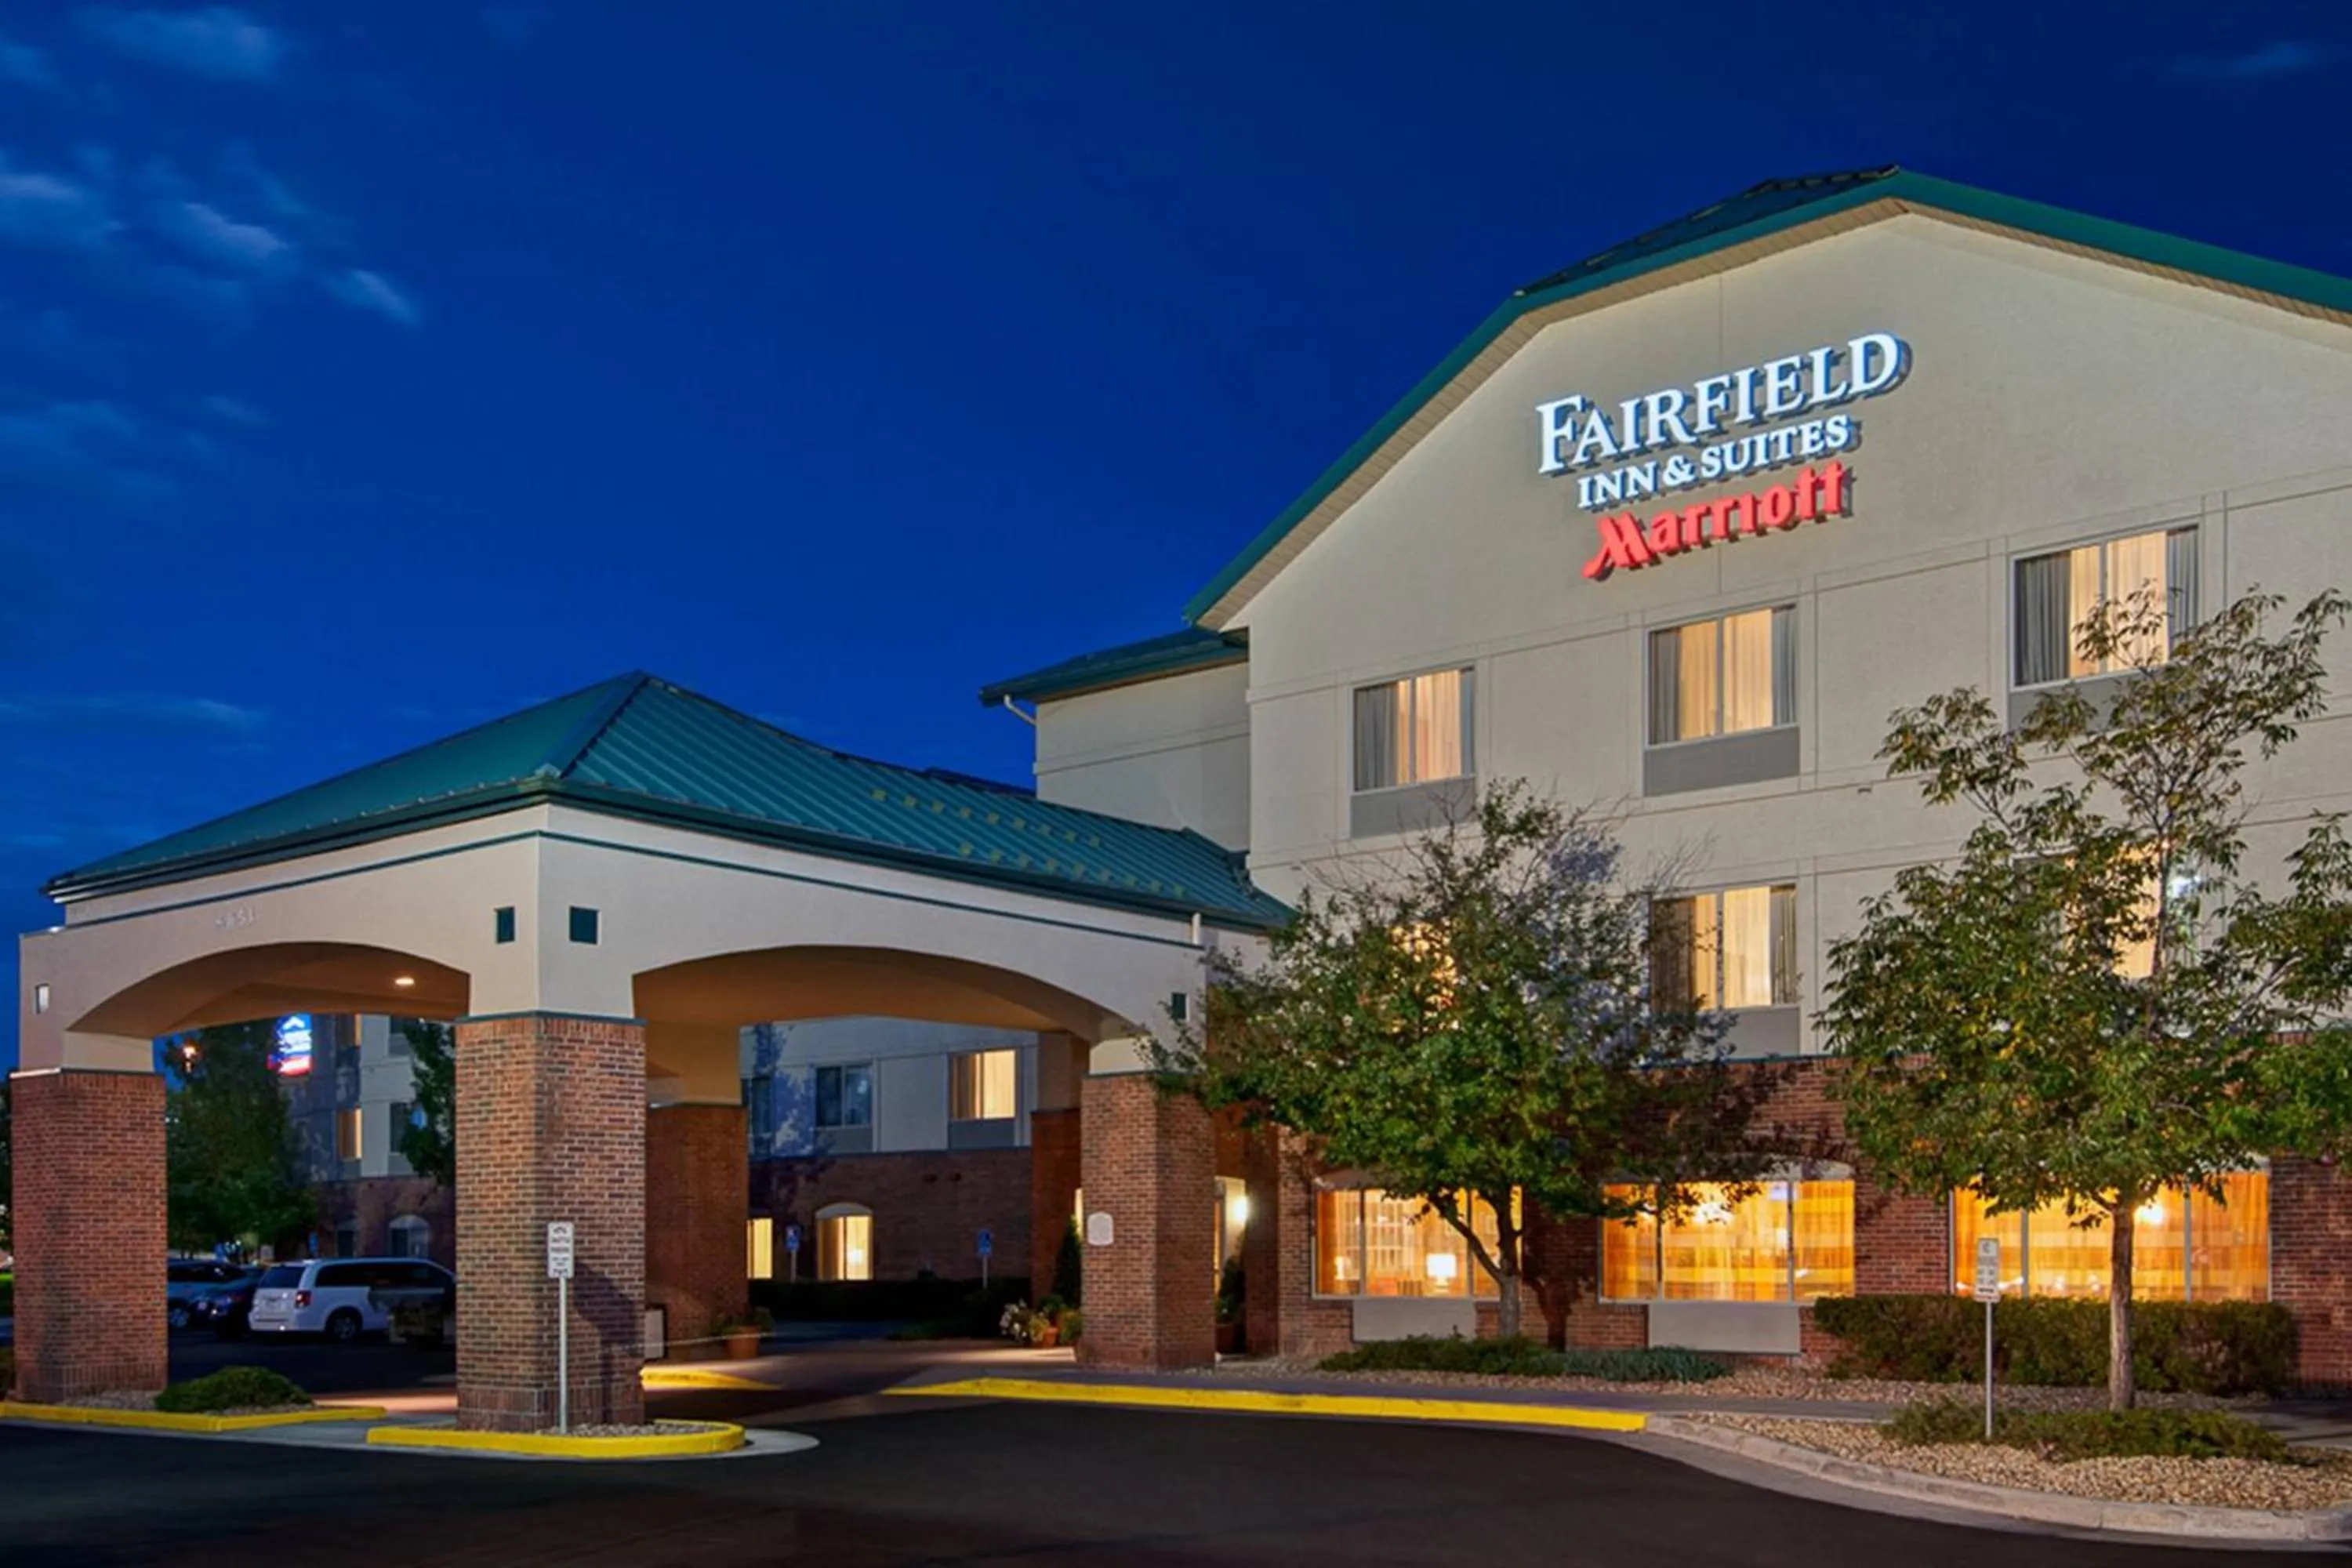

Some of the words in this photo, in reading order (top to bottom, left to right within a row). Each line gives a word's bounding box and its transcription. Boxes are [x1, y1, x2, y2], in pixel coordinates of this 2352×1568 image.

[1535, 331, 1905, 474] FAIRFIELD
[1577, 461, 1659, 510] INN
[1662, 454, 1696, 487] &
[1700, 414, 1853, 478] SUITES
[1581, 459, 1849, 579] Marriott
